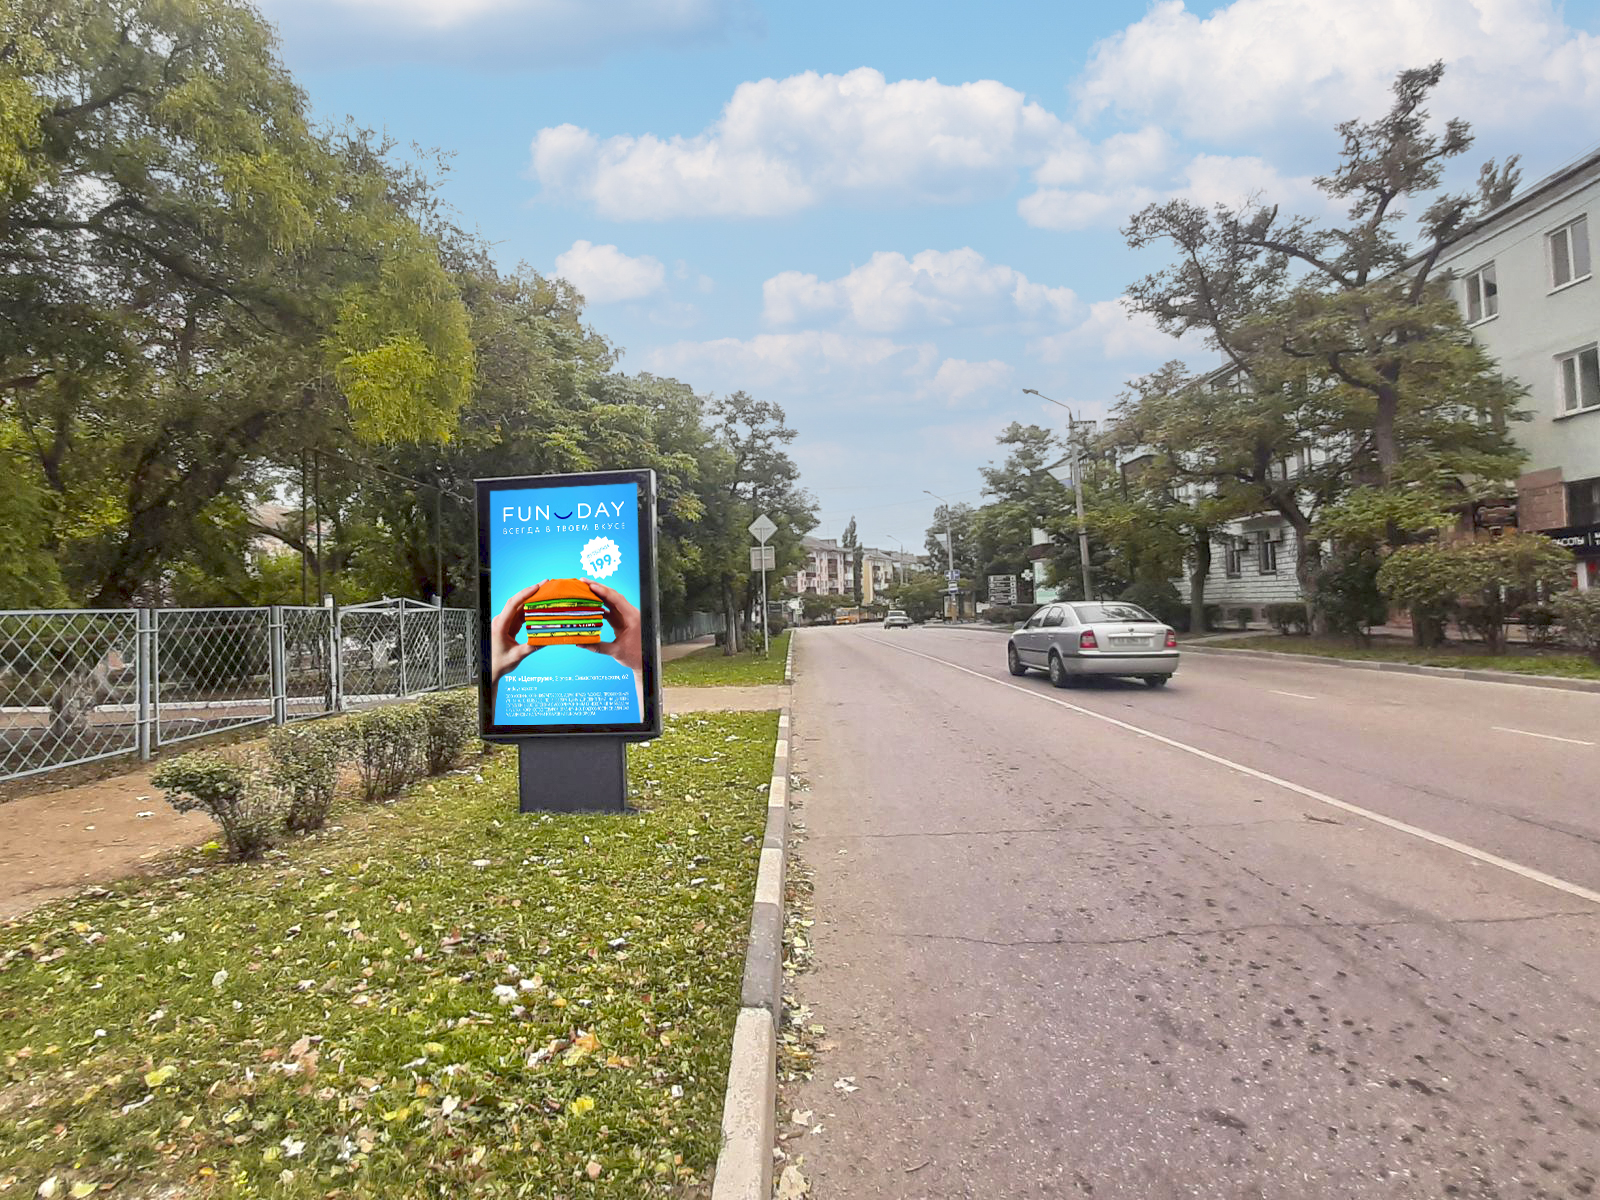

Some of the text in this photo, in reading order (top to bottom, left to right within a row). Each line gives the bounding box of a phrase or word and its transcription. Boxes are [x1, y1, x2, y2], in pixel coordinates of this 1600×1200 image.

[503, 501, 624, 522] FUN DAY
[556, 524, 589, 532] ТВОЕМ
[595, 522, 625, 530] ВКУСЕ
